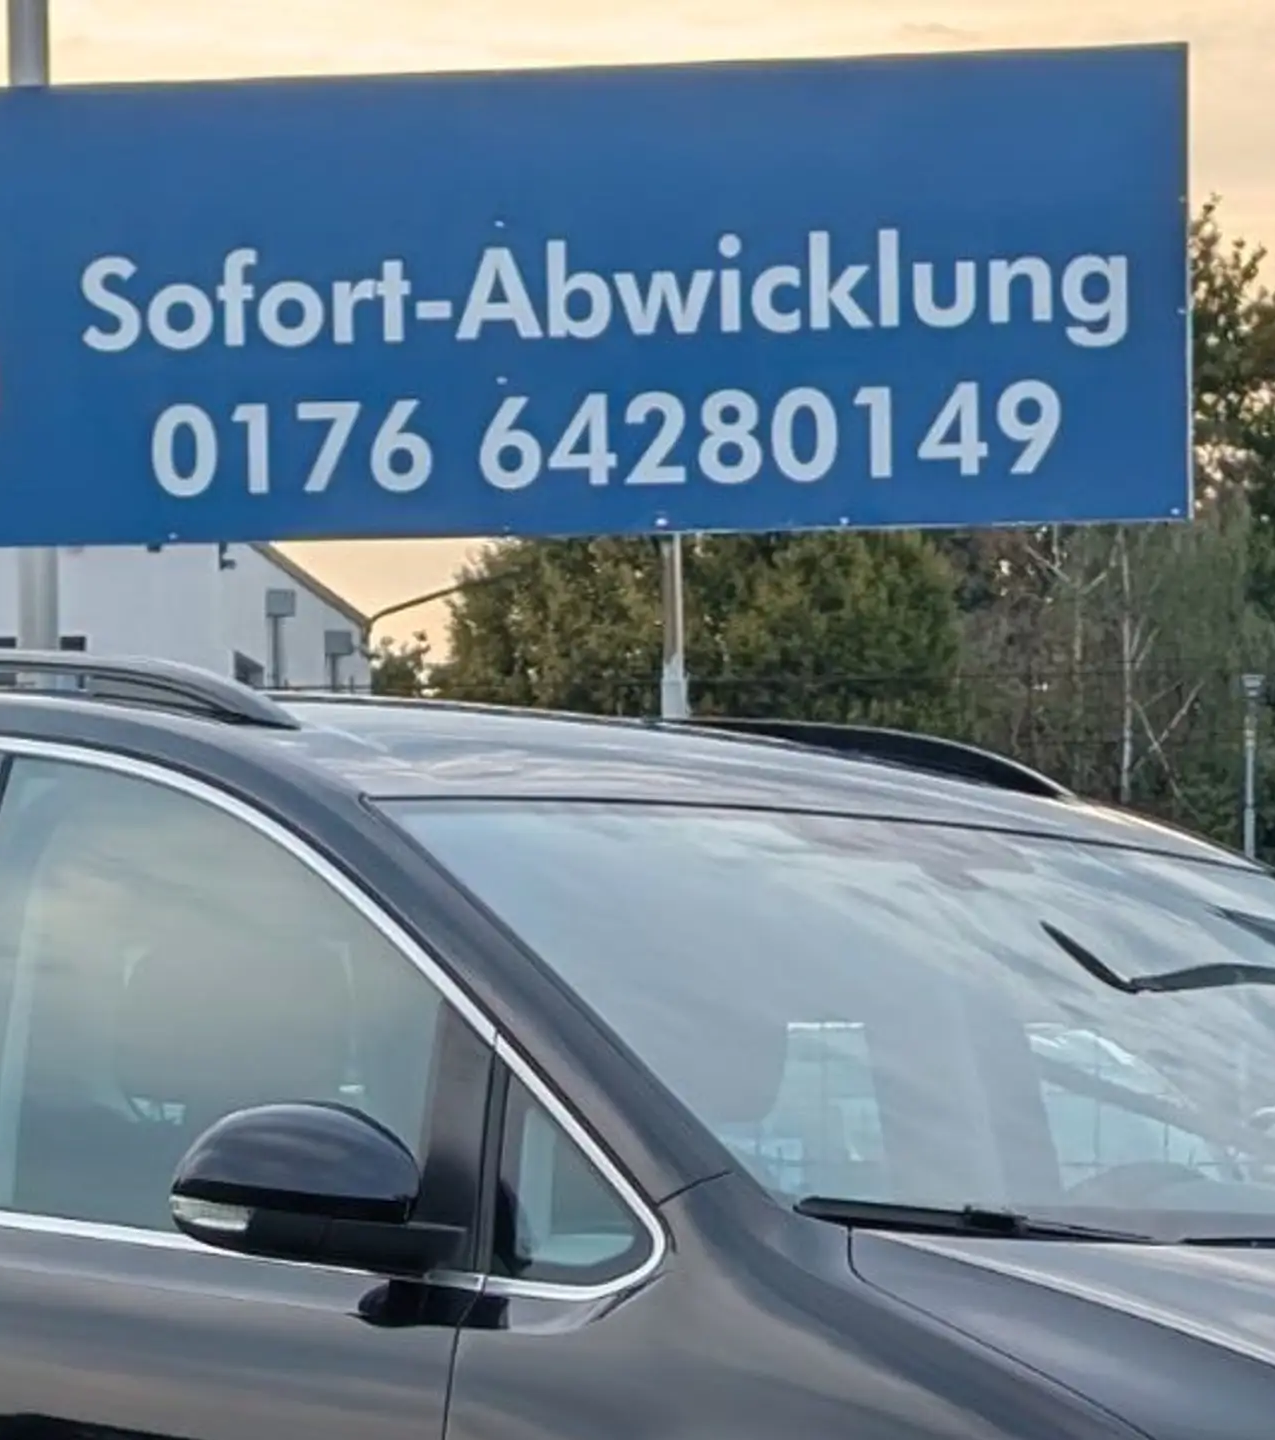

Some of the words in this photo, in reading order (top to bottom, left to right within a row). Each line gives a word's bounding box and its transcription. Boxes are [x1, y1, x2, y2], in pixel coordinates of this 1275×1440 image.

[81, 228, 1129, 352] Sofort-Abwicklung
[151, 398, 433, 498] 0176
[478, 378, 1062, 490] 64280149
